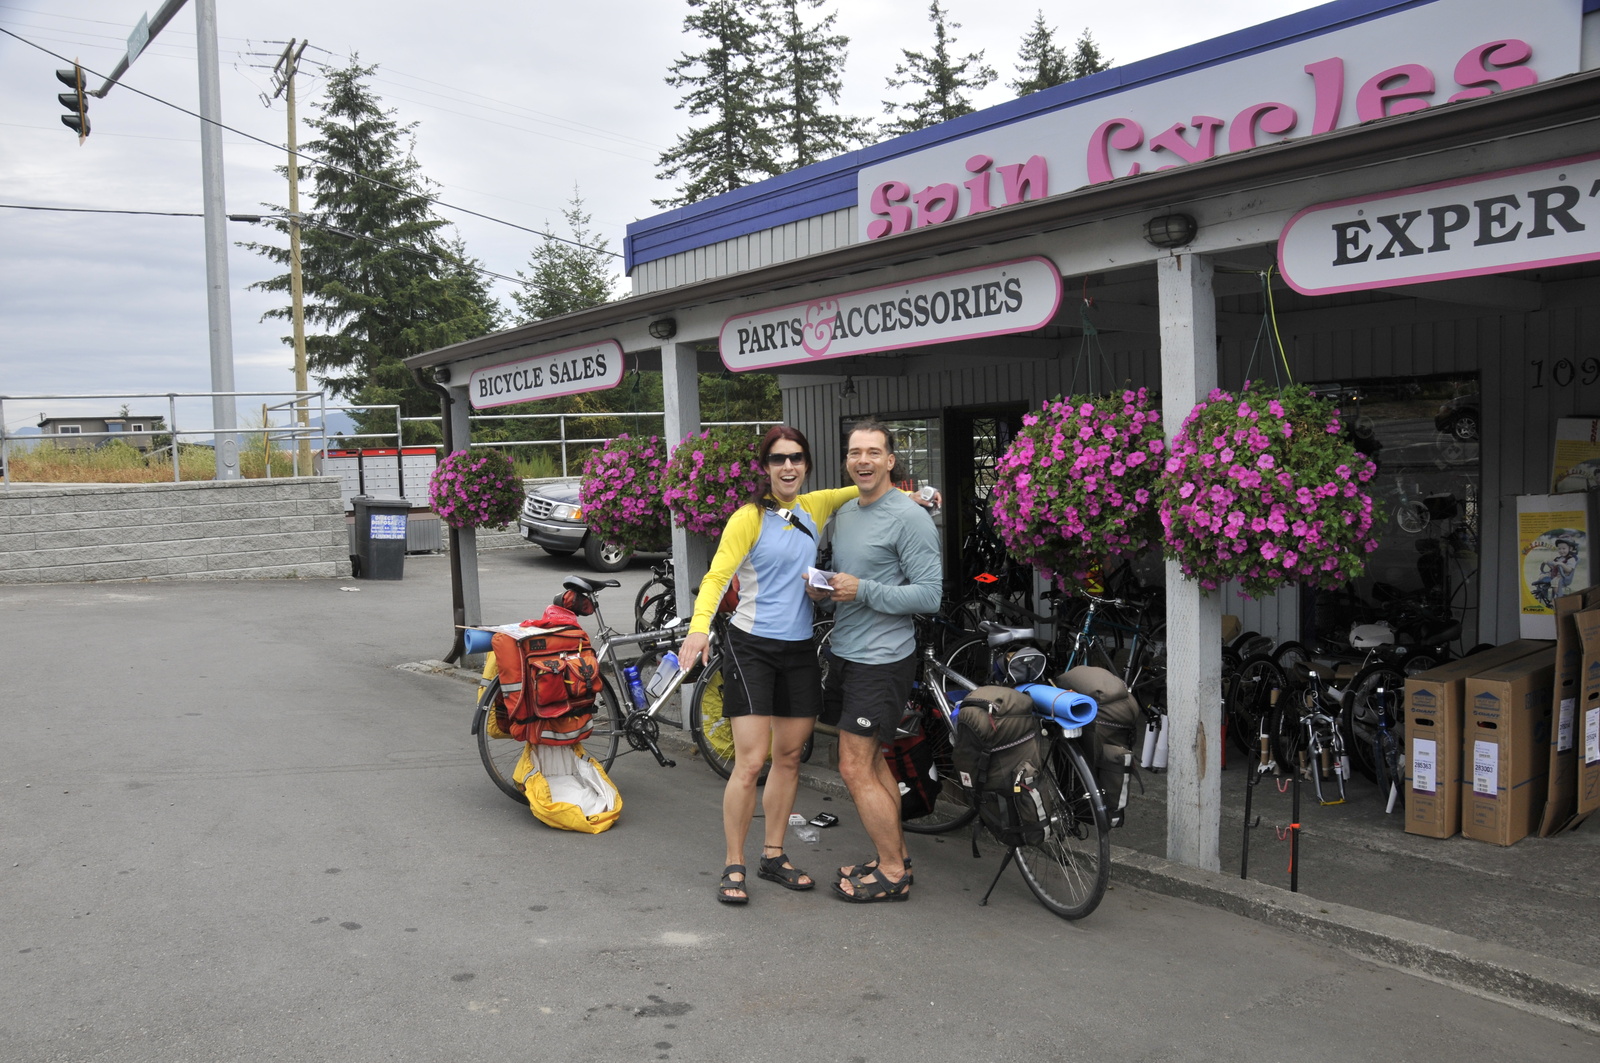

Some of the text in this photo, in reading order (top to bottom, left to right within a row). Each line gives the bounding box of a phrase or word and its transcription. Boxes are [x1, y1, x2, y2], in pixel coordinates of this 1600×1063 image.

[866, 154, 1048, 240] Spin
[1332, 178, 1600, 266] EXPER
[738, 278, 1023, 358] PARTS & ACCESSORIES
[479, 354, 607, 398] BICYCLE SALES
